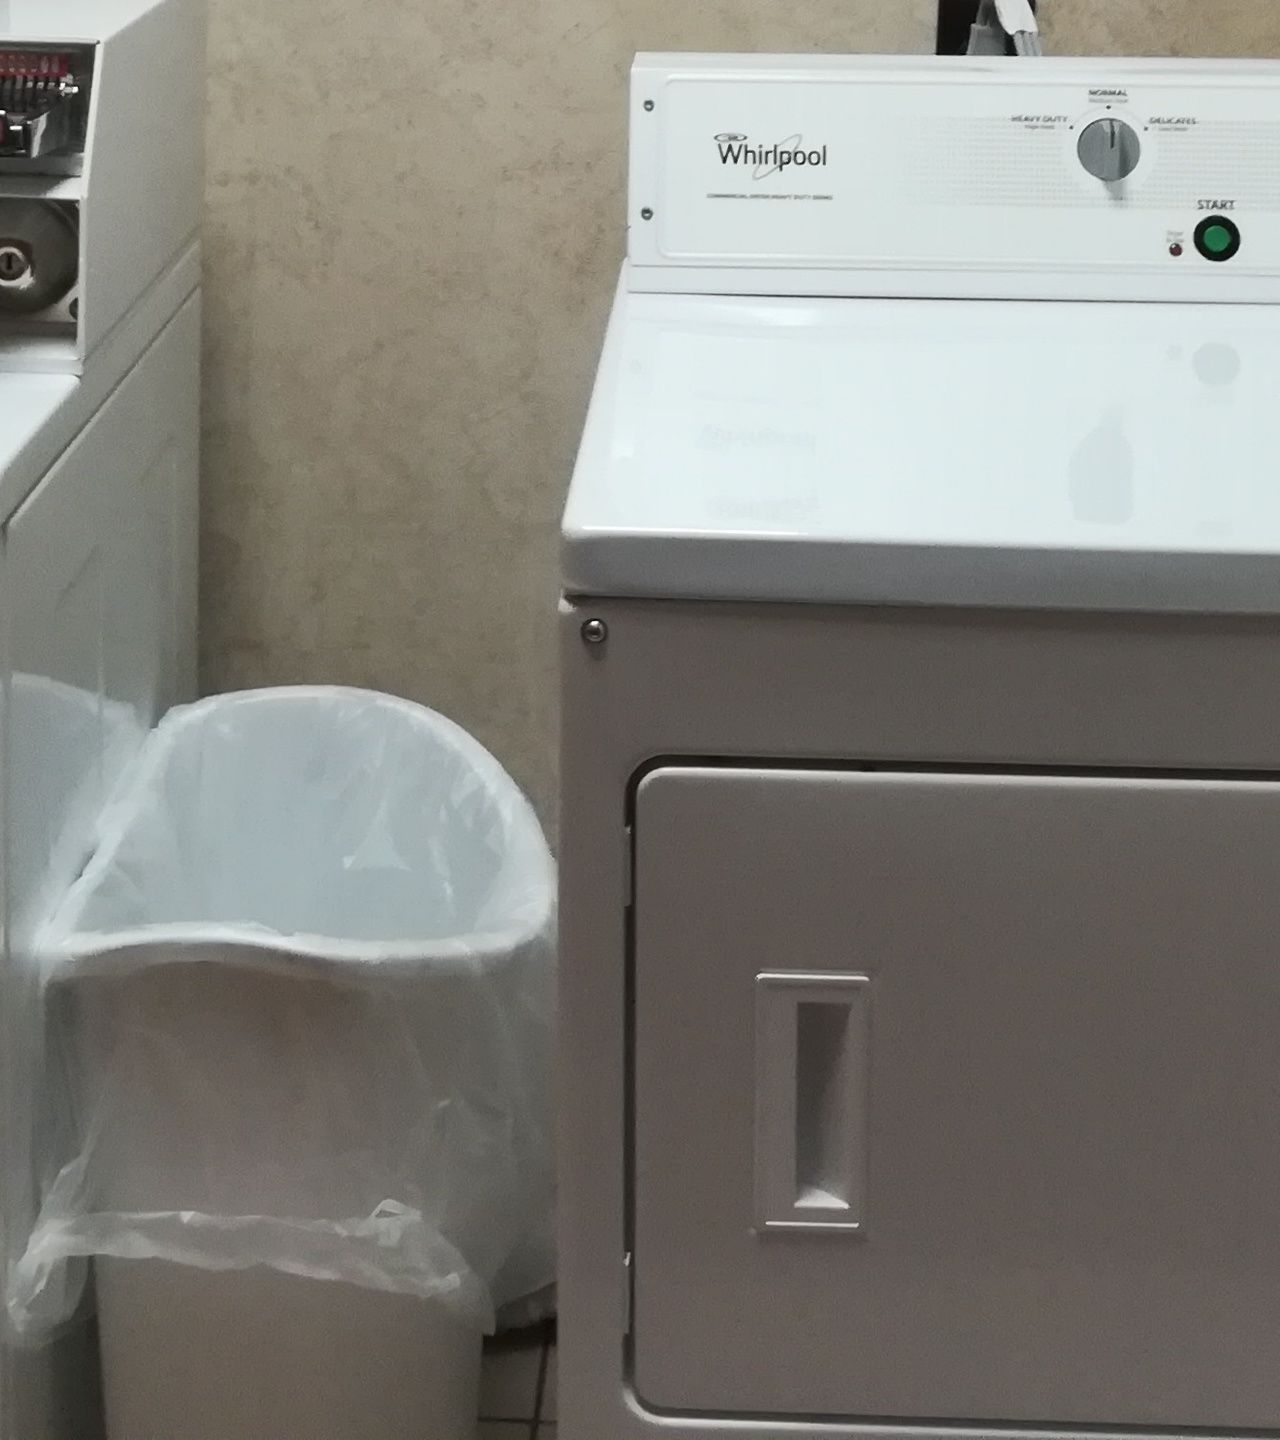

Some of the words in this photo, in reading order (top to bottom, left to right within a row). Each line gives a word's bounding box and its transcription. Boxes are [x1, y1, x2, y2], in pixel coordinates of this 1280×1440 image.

[1088, 89, 1129, 97] NORMAL
[1042, 115, 1069, 123] DUTY
[717, 143, 827, 172] Whirlpool
[1196, 199, 1236, 210] START
